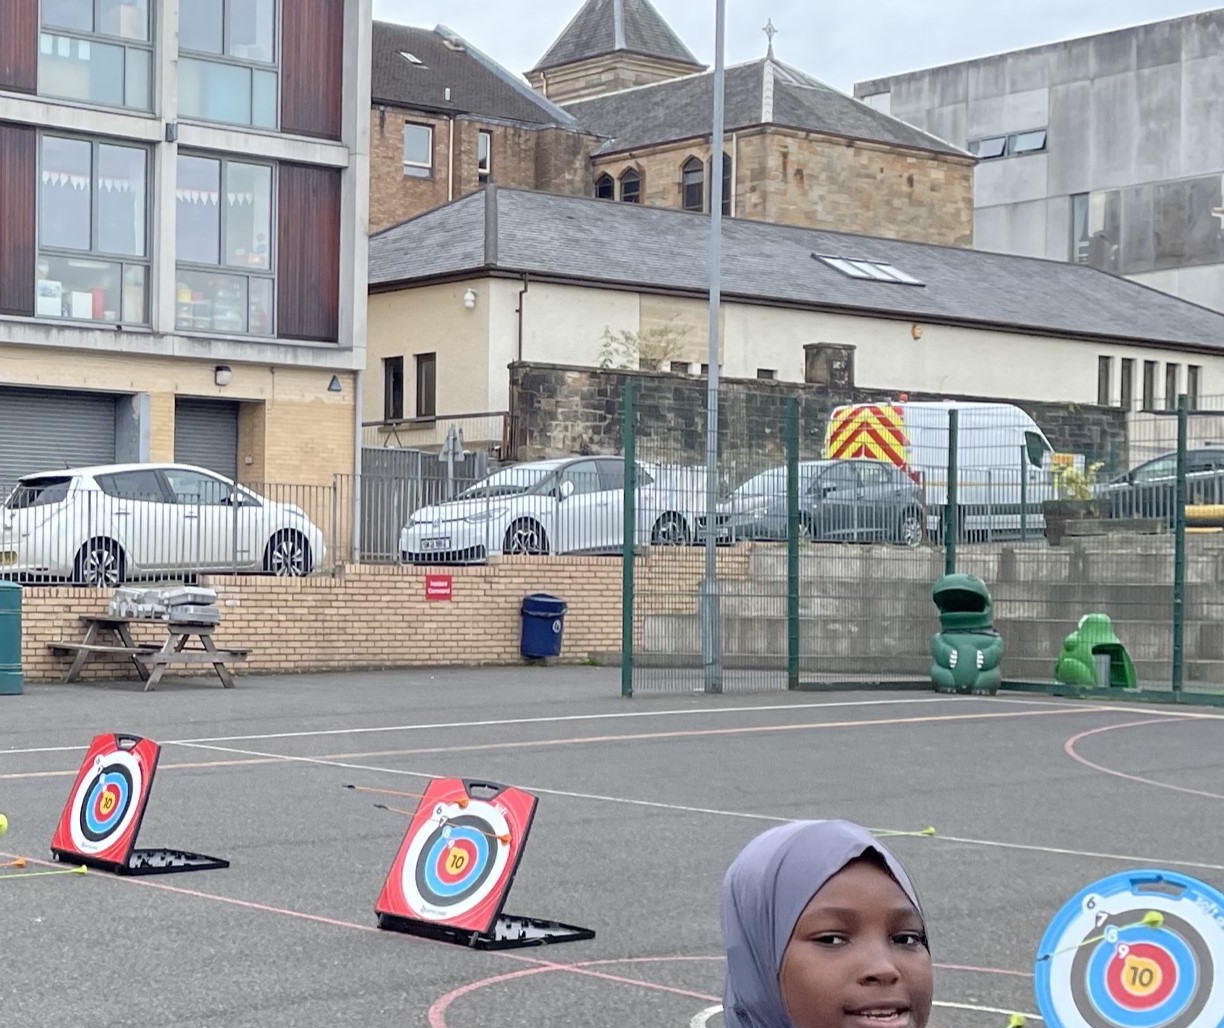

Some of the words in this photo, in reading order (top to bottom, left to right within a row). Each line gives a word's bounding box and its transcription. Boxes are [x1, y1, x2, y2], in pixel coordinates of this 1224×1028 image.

[103, 796, 113, 810] 10
[436, 805, 443, 815] 6
[450, 854, 465, 869] 10
[1086, 896, 1096, 910] 6
[1096, 911, 1109, 928] 7
[1118, 944, 1130, 959] 9
[1130, 966, 1154, 987] 10
